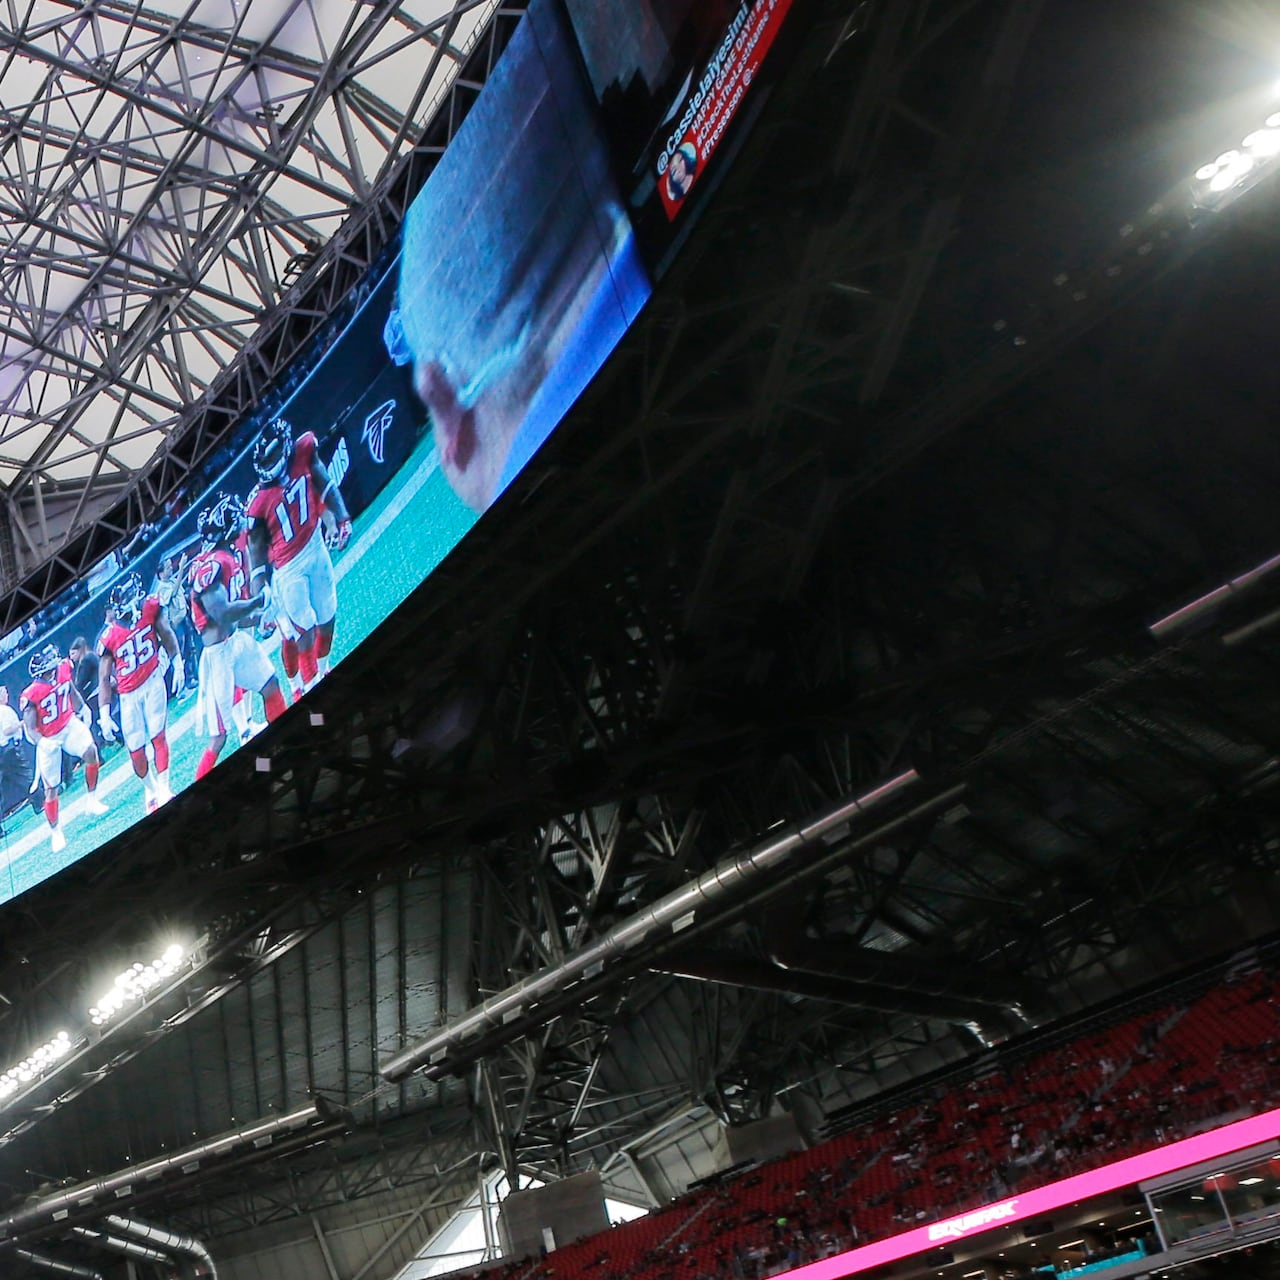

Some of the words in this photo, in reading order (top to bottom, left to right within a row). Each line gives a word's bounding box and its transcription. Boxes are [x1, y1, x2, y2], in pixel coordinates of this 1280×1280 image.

[657, 2, 750, 176] @CassieJaiyesimi
[691, 89, 717, 135] HAPPY
[715, 50, 738, 90] GAME
[736, 11, 757, 52] DAY!!
[696, 12, 770, 147] #CheckTheLastName
[701, 86, 744, 161] #Preseason
[275, 476, 308, 542] 17
[115, 624, 155, 677] 35
[40, 682, 71, 724] 37
[928, 1200, 1020, 1242] EQUIFAX
